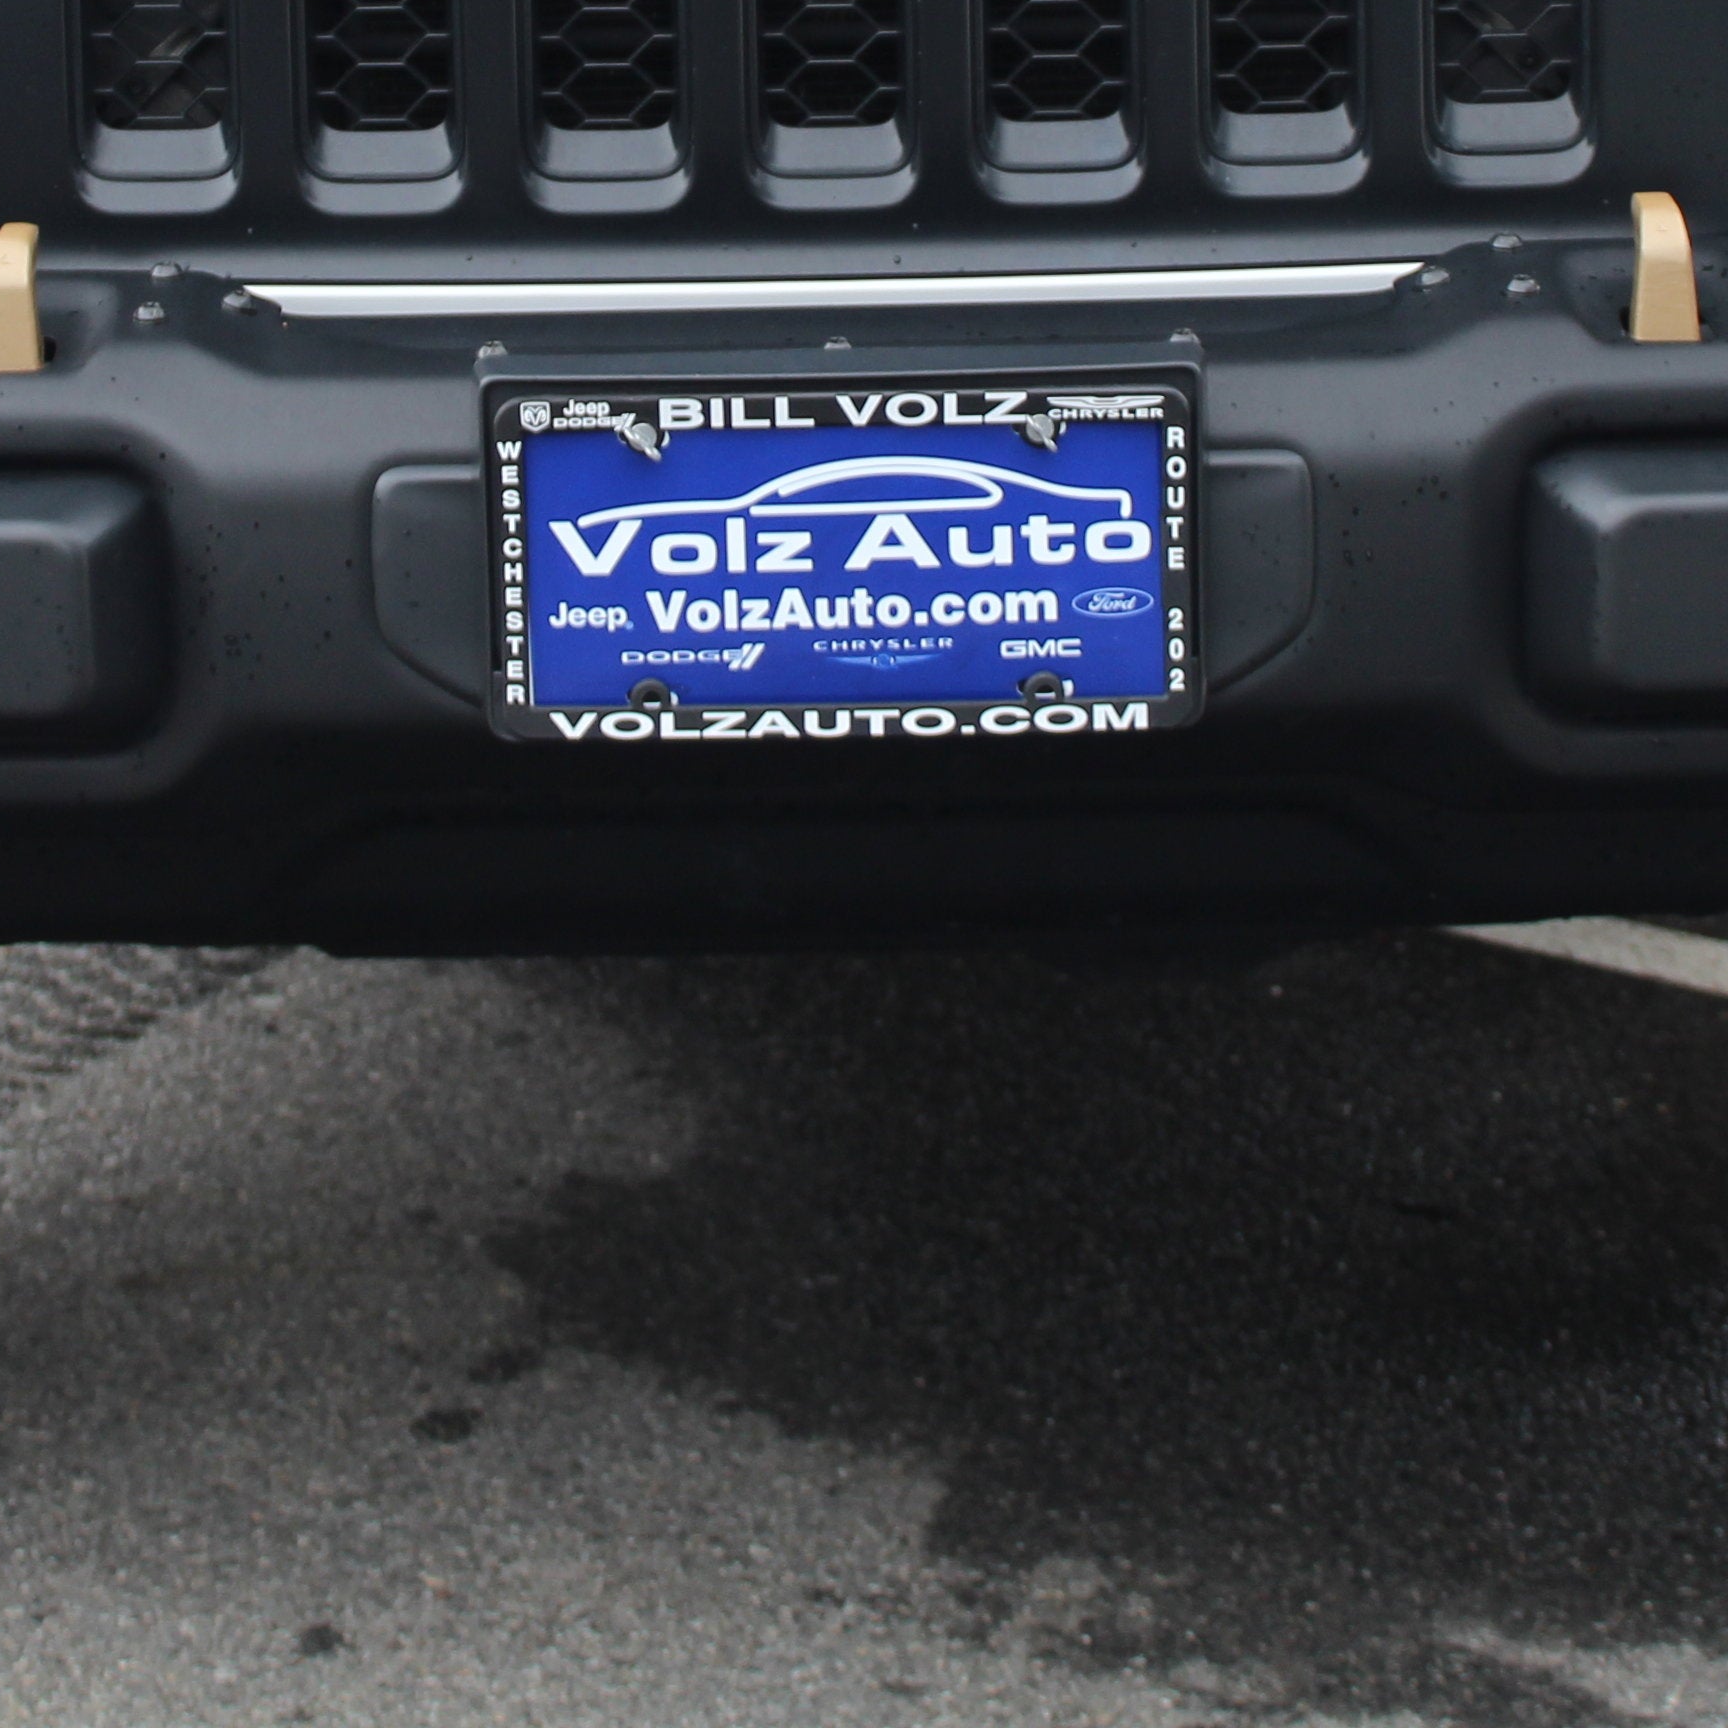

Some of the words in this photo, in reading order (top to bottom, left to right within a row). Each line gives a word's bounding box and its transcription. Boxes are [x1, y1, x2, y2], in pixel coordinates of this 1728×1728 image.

[552, 416, 621, 430] DODGE
[562, 399, 610, 418] Jeep
[658, 396, 815, 431] BILL
[835, 390, 1029, 427] VOLZ
[1048, 404, 1165, 420] CHRYSLER
[1165, 425, 1186, 571] ROUTE
[548, 517, 814, 577] Volz
[843, 513, 1152, 571] Auto
[496, 440, 525, 706] WESTCHESTER
[548, 603, 627, 632] Jeep
[645, 587, 1059, 633] VolzAuto.com
[1087, 590, 1139, 613] Ford
[621, 649, 741, 665] DODGE
[812, 637, 955, 654] CHRYSLER
[999, 638, 1083, 660] GMC
[1167, 608, 1186, 694] 202
[549, 703, 1150, 740] VOLZAUTO.COM
